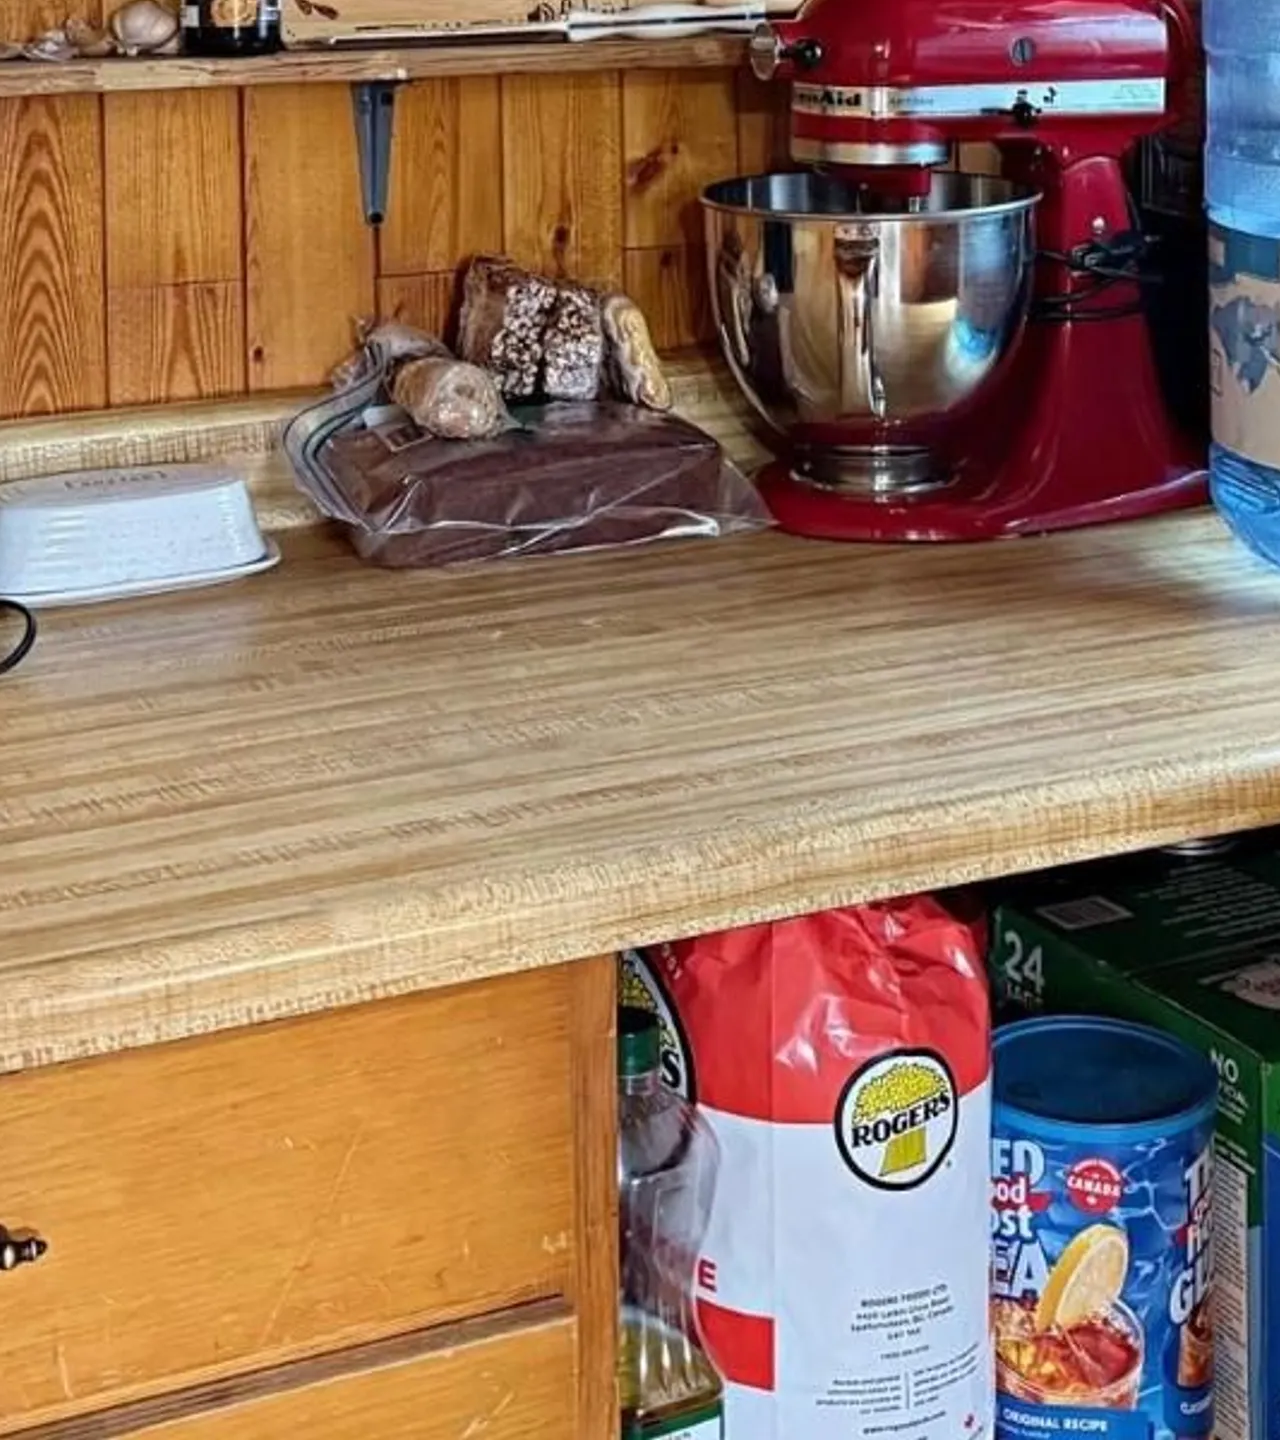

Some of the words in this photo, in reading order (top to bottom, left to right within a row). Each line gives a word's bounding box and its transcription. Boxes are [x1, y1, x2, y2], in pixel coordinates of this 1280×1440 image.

[1004, 929, 1045, 995] 24
[851, 1090, 951, 1149] ROGERS
[1066, 1174, 1121, 1198] CANADA
[1001, 1407, 1061, 1431] ORIGINAL
[1062, 1415, 1110, 1433] RECIPE
